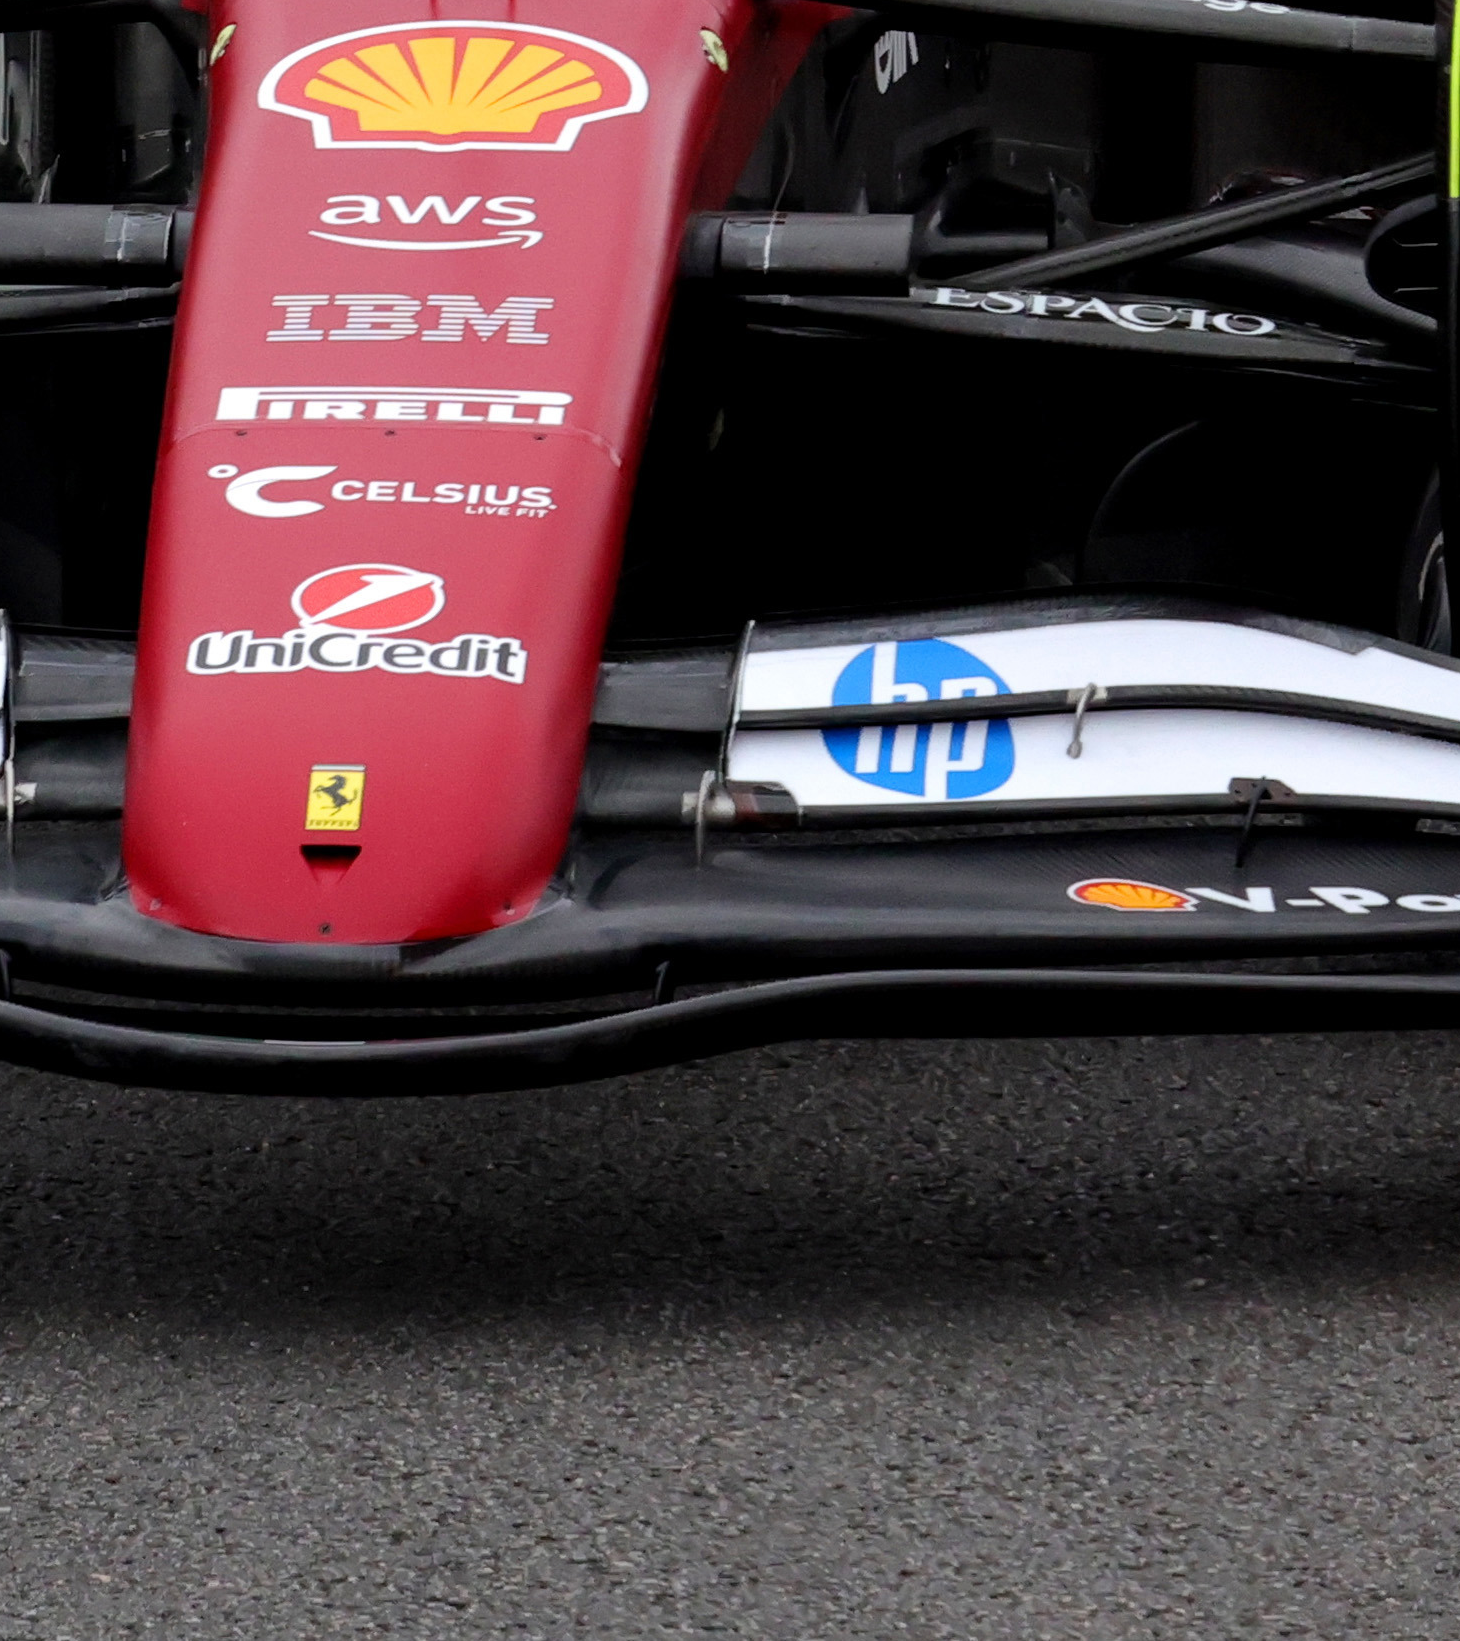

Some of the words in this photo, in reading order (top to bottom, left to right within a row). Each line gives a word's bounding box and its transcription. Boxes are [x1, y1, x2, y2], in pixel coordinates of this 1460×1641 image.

[319, 193, 538, 226] aws
[265, 293, 555, 345] IBM
[215, 386, 574, 426] PIRELLI
[464, 505, 512, 516] LIVE
[515, 507, 550, 519] FIT
[194, 630, 522, 680] UniCredit
[852, 638, 999, 800] hp
